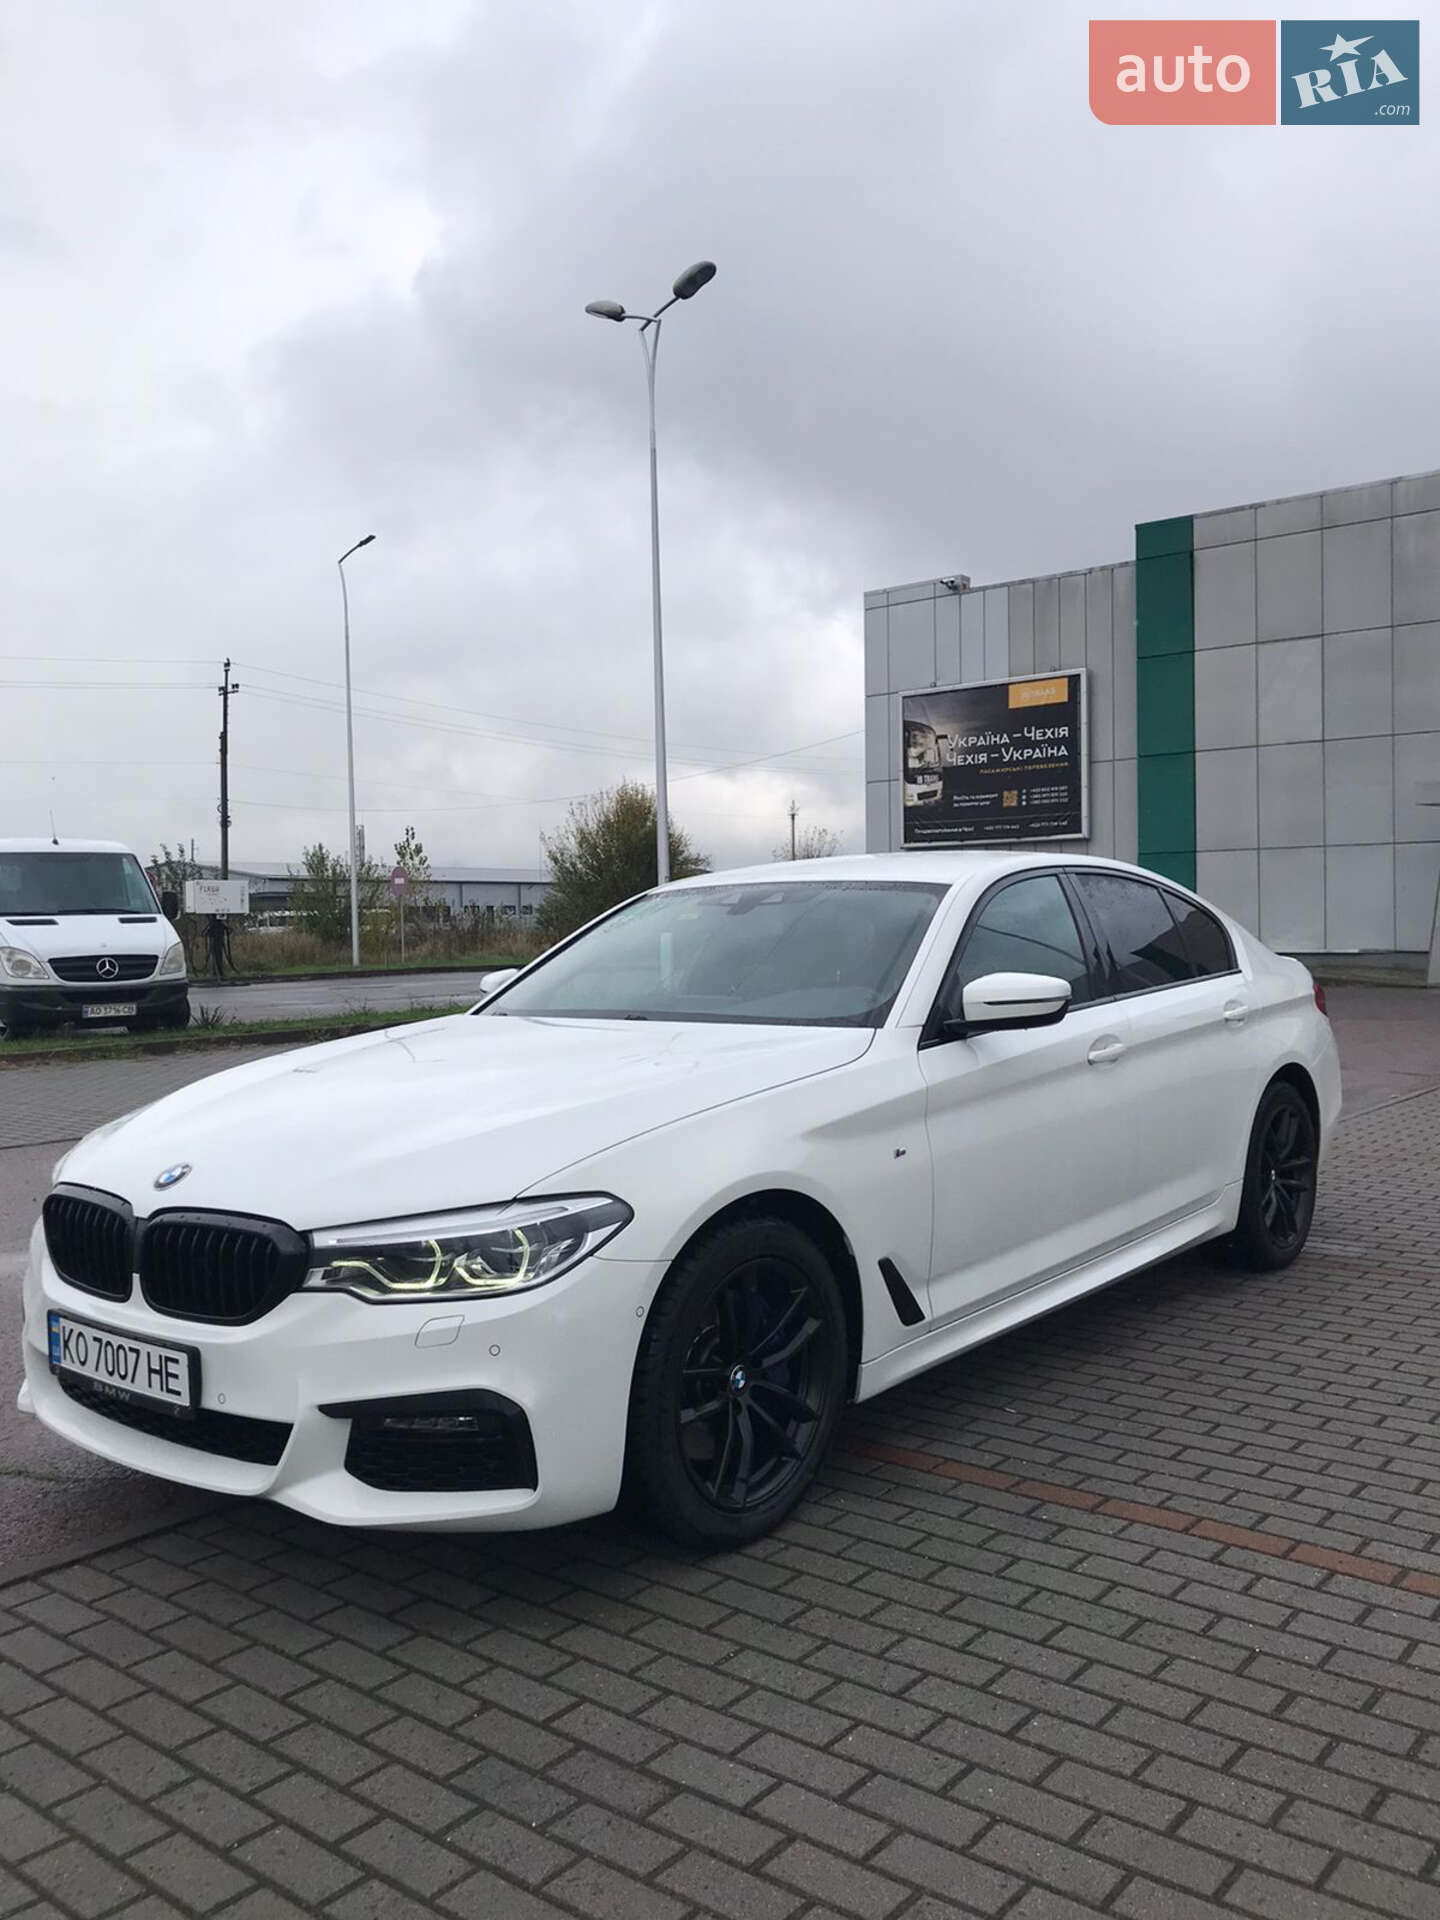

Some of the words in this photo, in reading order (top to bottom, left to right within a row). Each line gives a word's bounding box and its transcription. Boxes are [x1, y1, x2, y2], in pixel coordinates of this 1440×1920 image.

[62, 1325, 88, 1367] KO
[92, 1336, 141, 1384] 7007
[147, 1351, 182, 1397] HE
[93, 1381, 132, 1401] BMW
